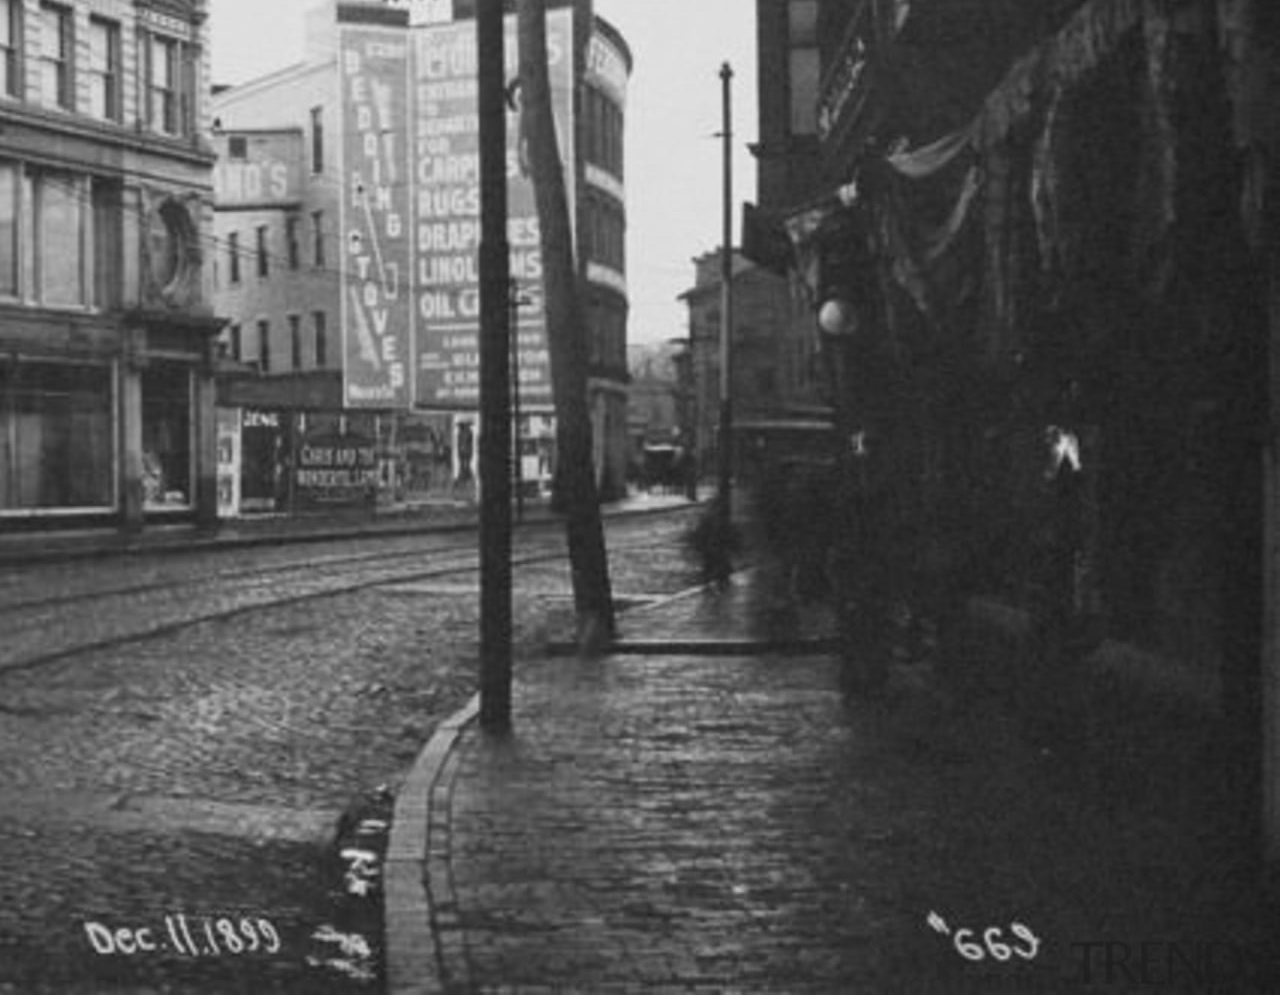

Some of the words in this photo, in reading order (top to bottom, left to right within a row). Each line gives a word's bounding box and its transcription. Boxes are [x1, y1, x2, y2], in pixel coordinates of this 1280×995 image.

[419, 152, 522, 184] CARPS
[419, 186, 479, 219] RUGS
[419, 216, 541, 252] DRAPES
[420, 253, 542, 285] LINOLMS
[348, 230, 403, 388] STOVES
[420, 291, 456, 320] OIL
